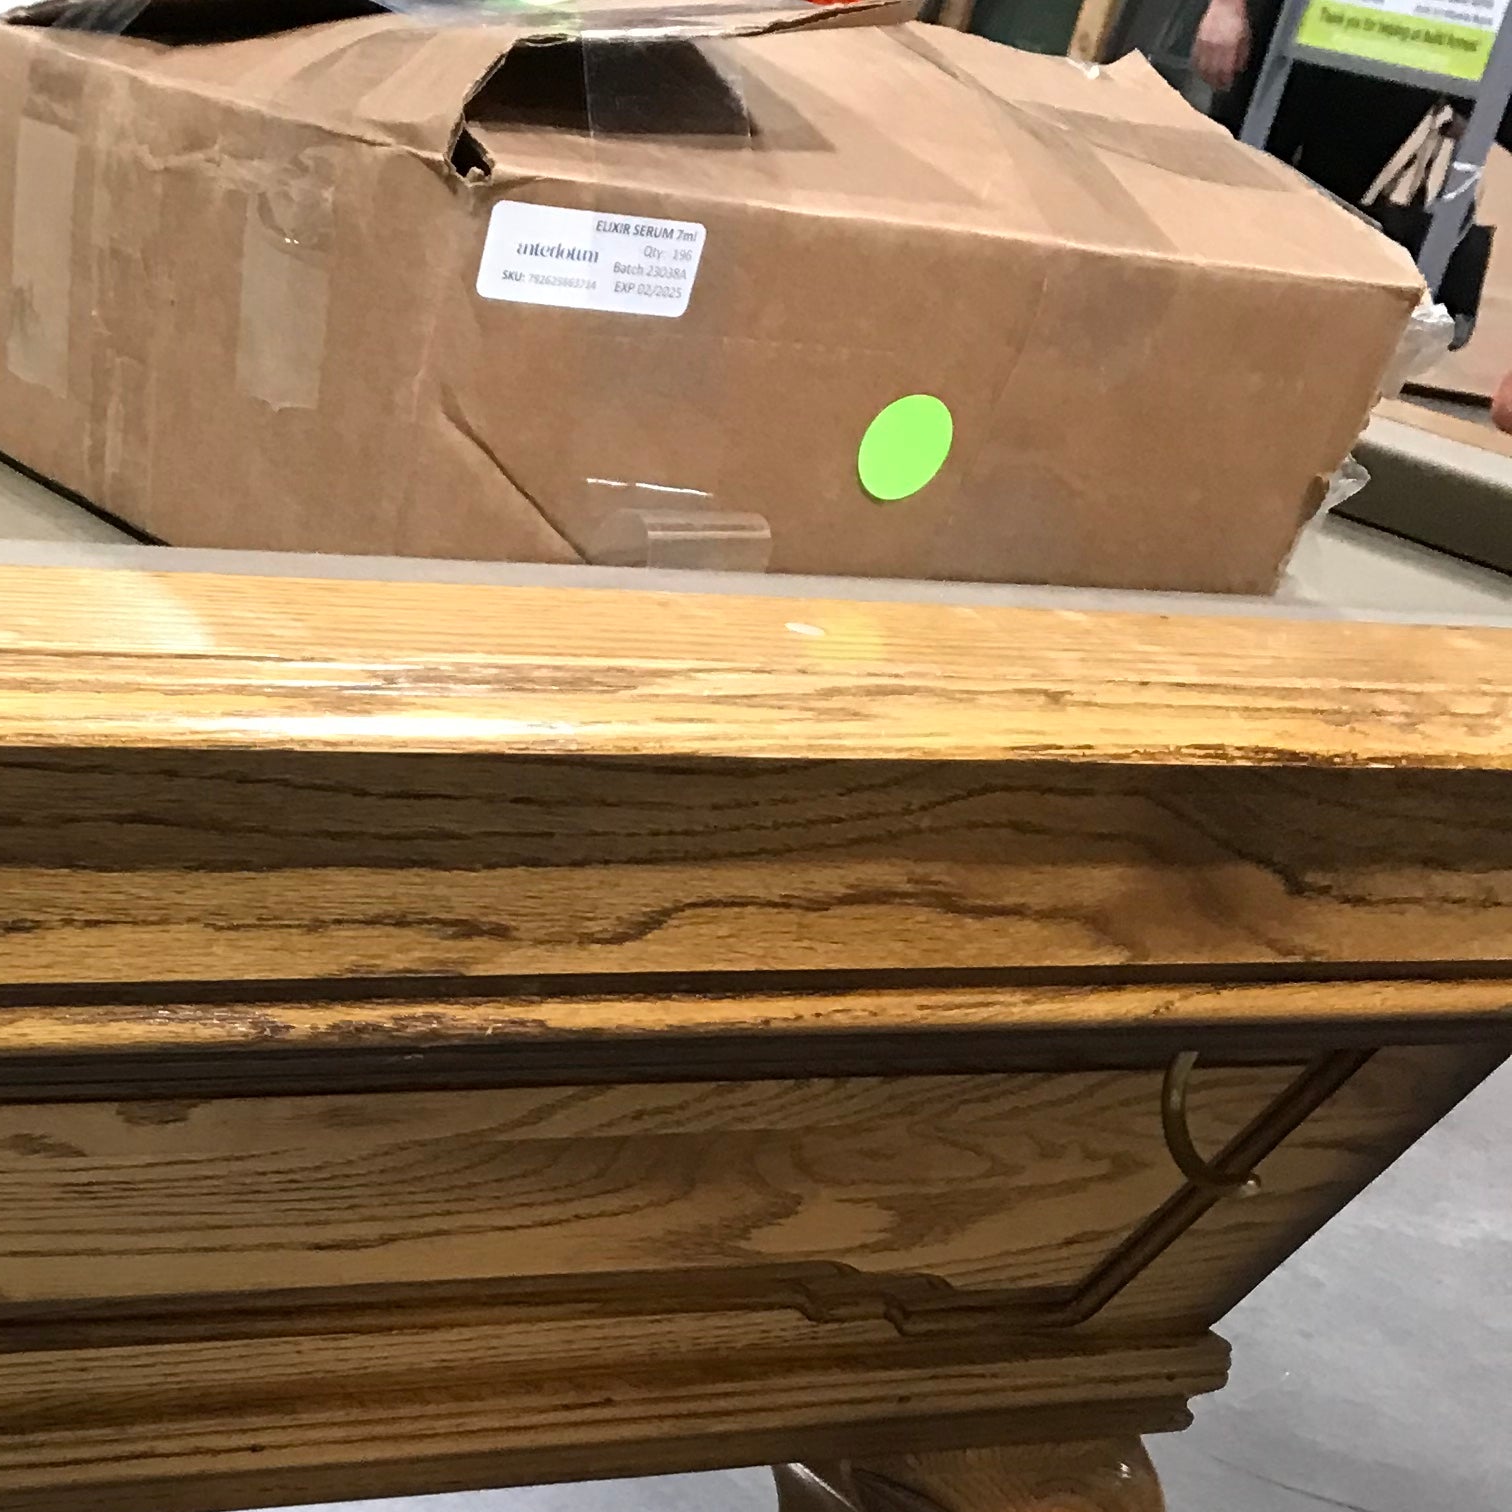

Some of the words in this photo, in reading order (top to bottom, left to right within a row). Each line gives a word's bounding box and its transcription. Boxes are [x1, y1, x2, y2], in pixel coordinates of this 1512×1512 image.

[596, 220, 630, 235] ELIXIR
[632, 224, 675, 240] SERUM
[675, 229, 698, 242] 7ml
[613, 261, 644, 276] Batch
[613, 281, 635, 294] EXP
[636, 283, 683, 299] 02/2025
